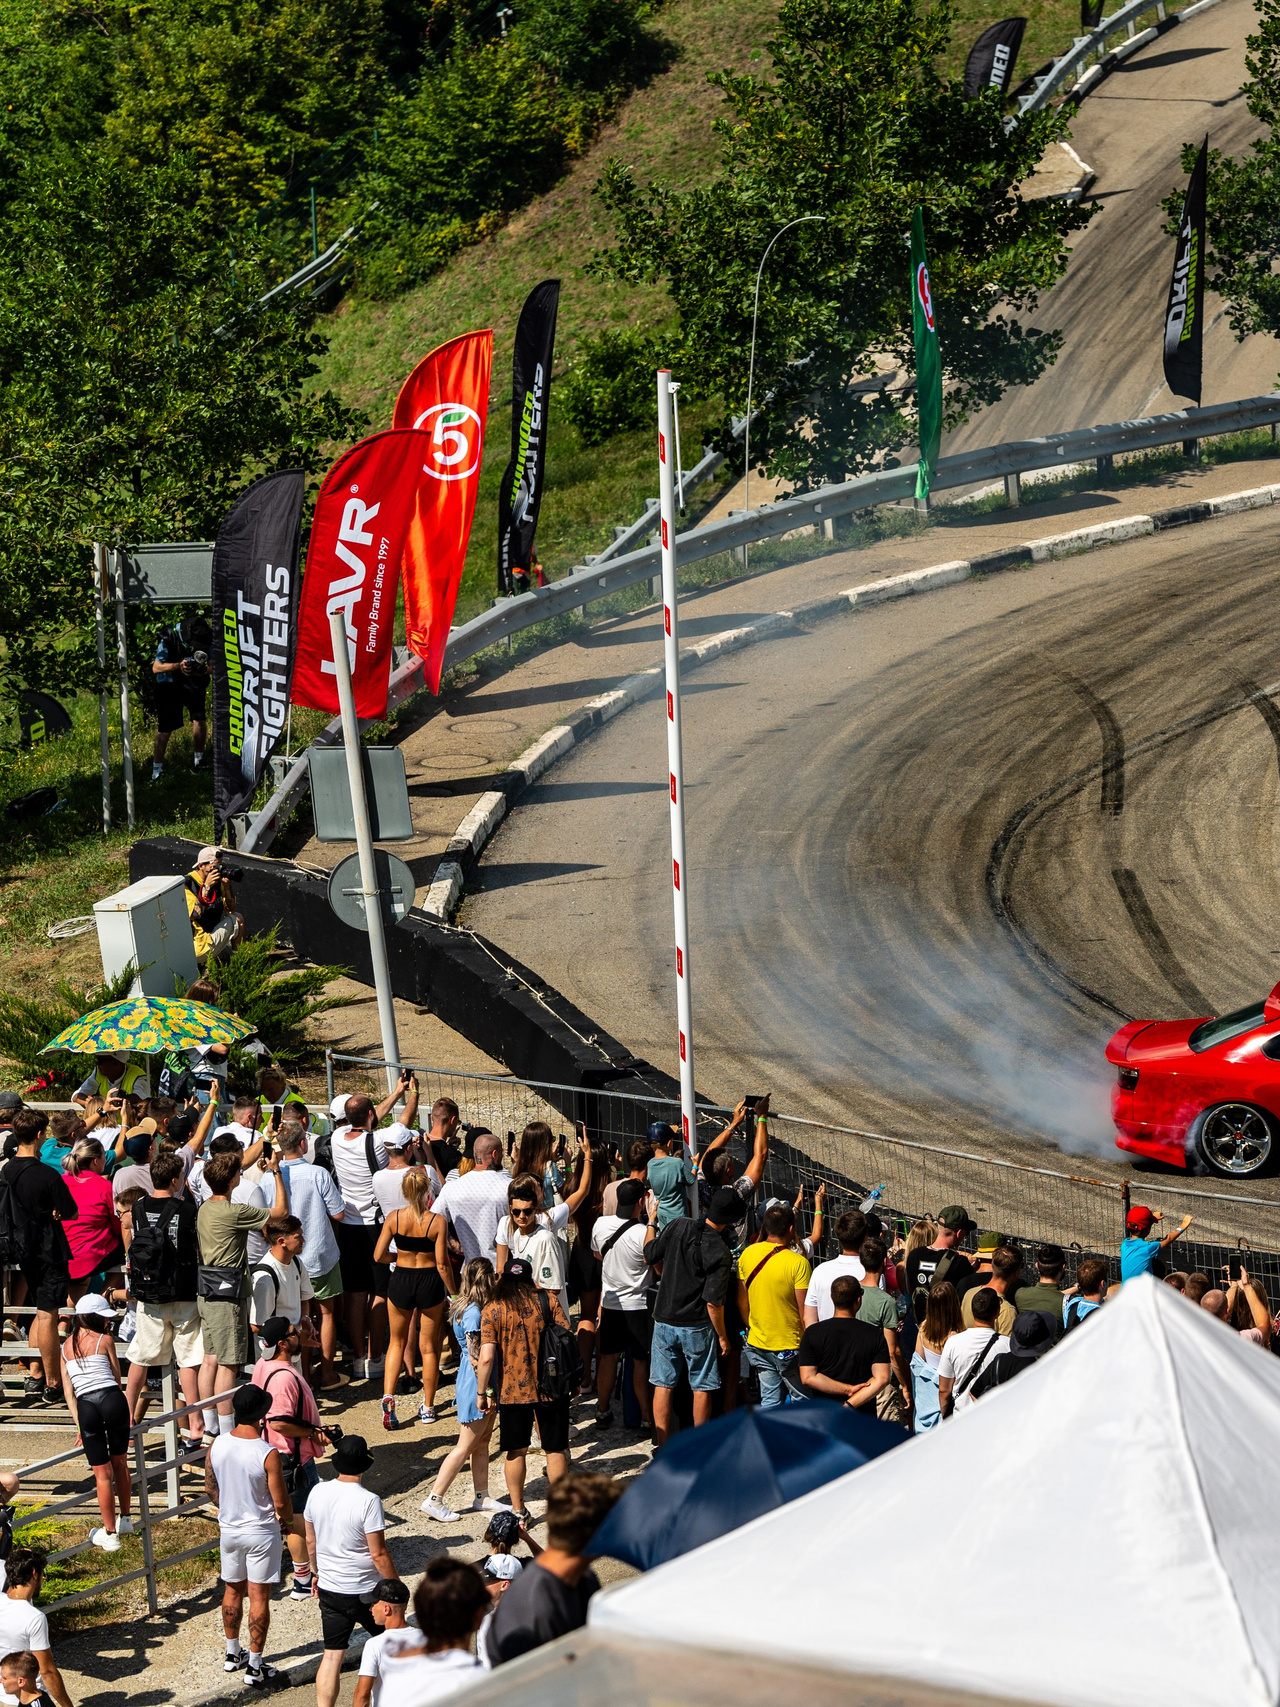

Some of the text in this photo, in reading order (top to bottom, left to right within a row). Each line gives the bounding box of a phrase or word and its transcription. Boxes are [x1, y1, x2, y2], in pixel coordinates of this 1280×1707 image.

[432, 407, 469, 465] 5
[261, 563, 290, 759] FIGHTERS
[365, 537, 390, 653] Family Brand since 1997
[223, 608, 241, 757] GROUNDED
[237, 590, 262, 782] DRIFT
